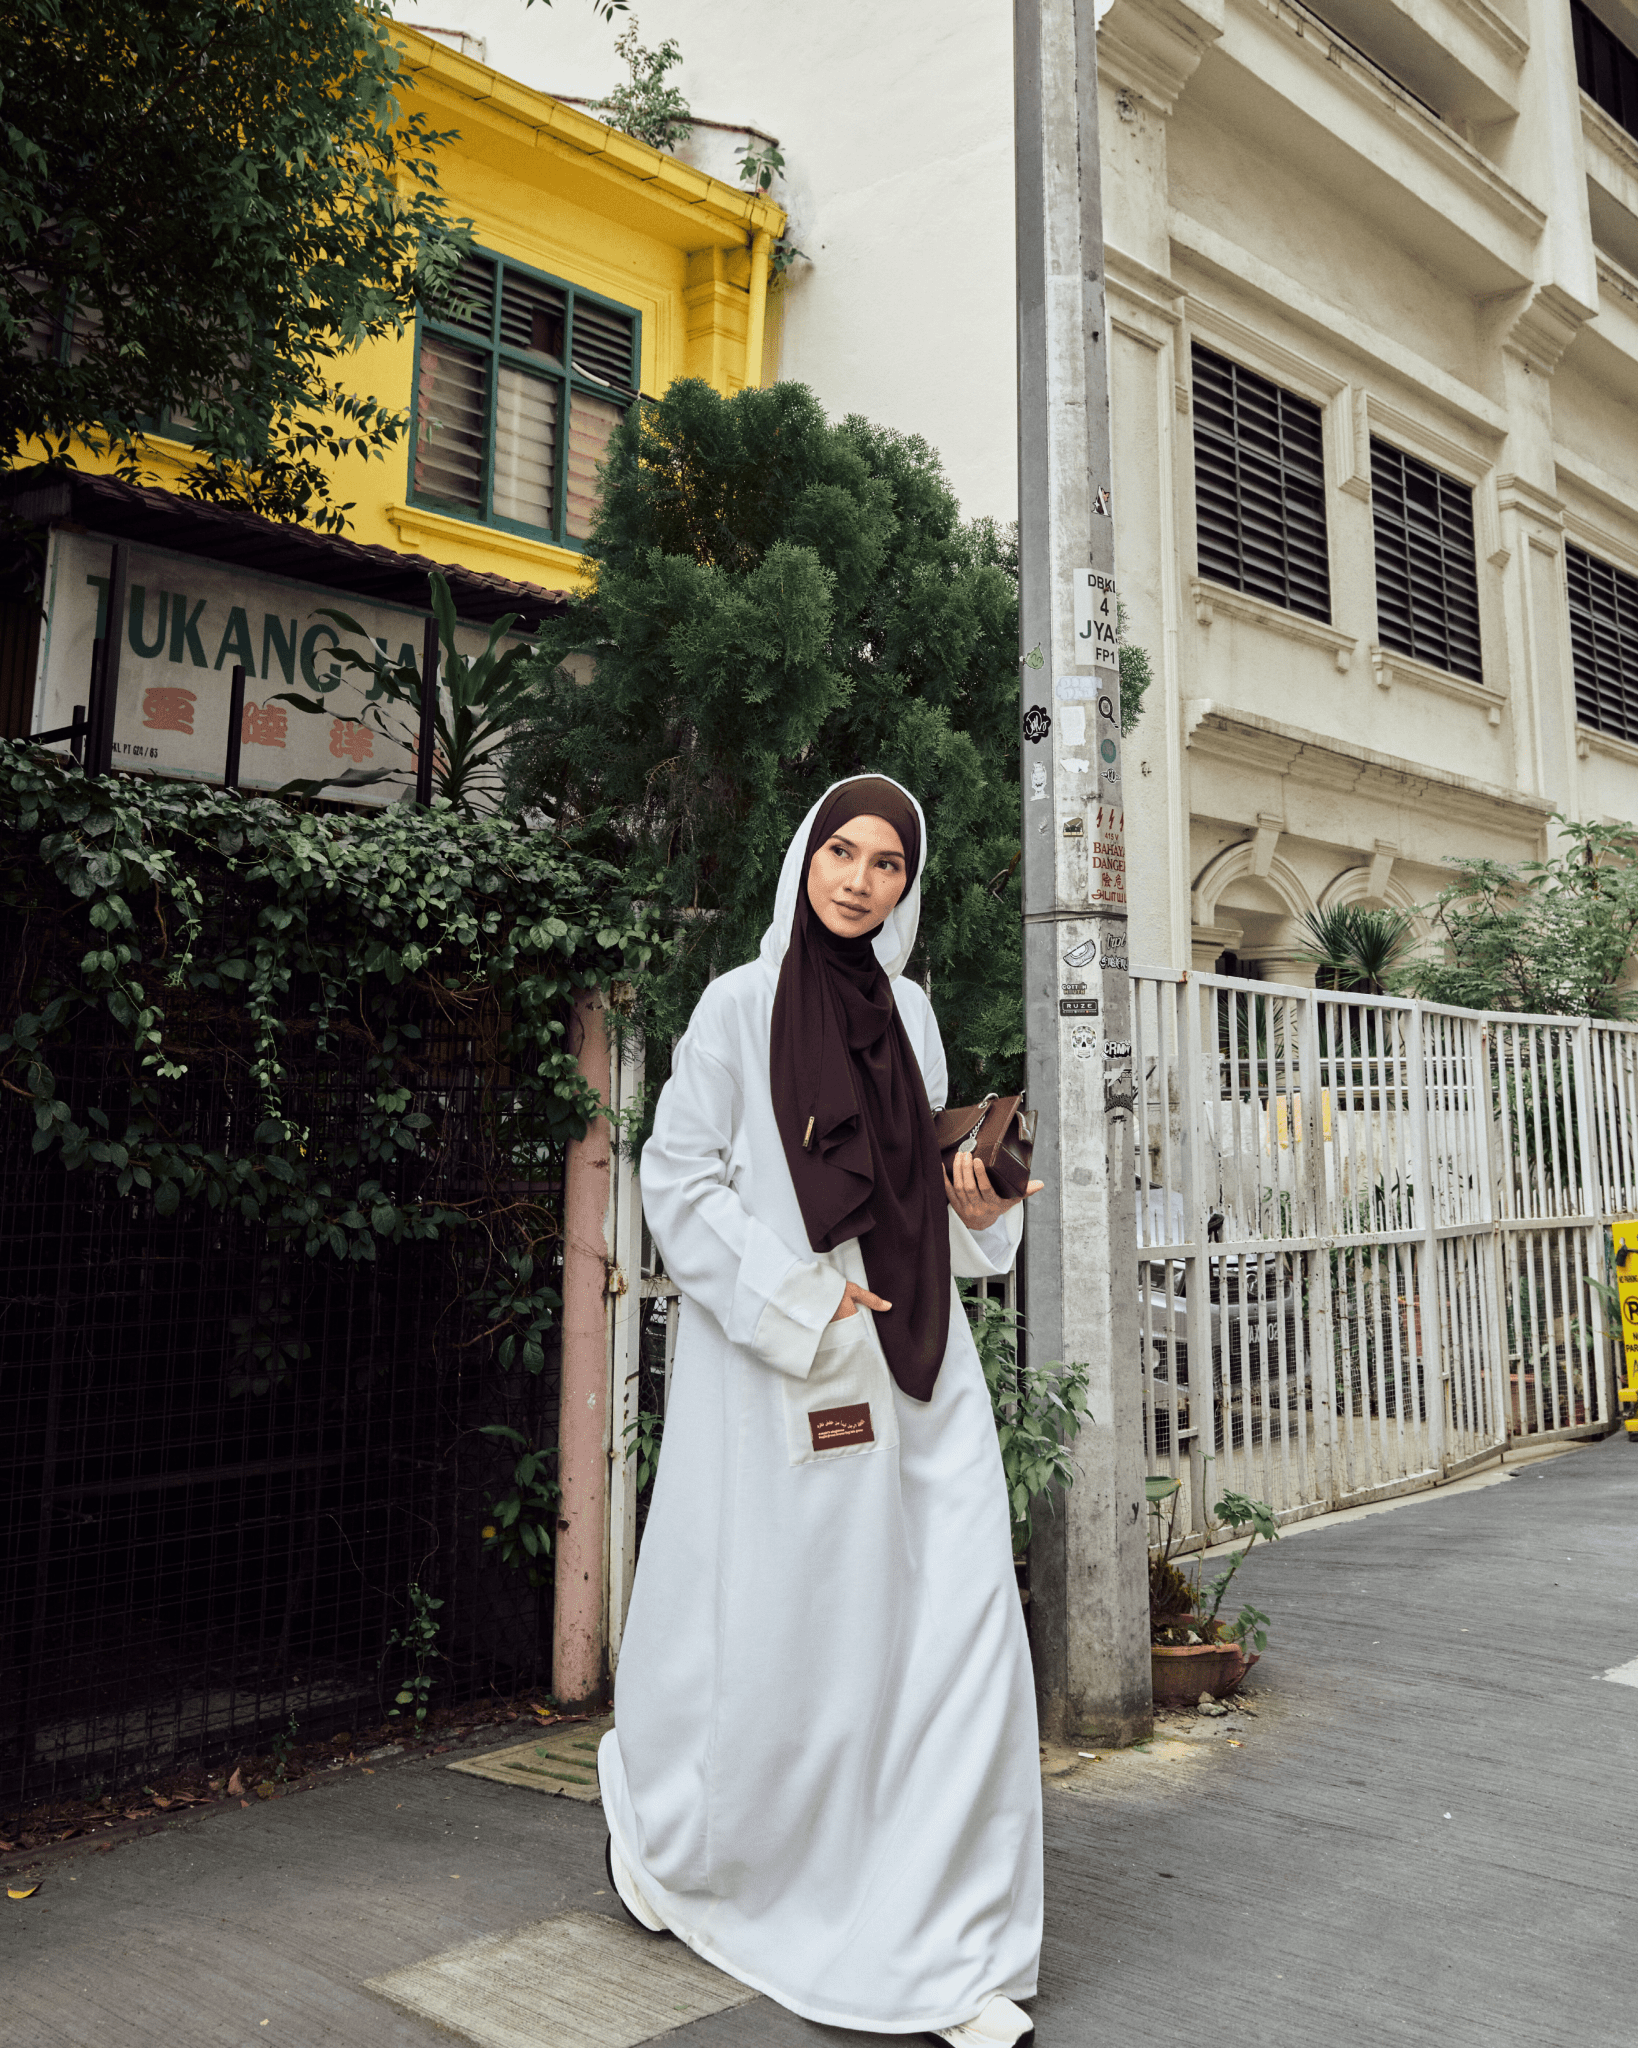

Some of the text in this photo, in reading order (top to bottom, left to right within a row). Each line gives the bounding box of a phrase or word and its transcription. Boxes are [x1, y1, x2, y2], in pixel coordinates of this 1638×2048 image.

[1100, 597, 1109, 616] 4
[1095, 647, 1115, 664] FP1
[123, 743, 132, 755] PT
[1105, 832, 1114, 840] 415
[1093, 842, 1125, 857] BAHAY
